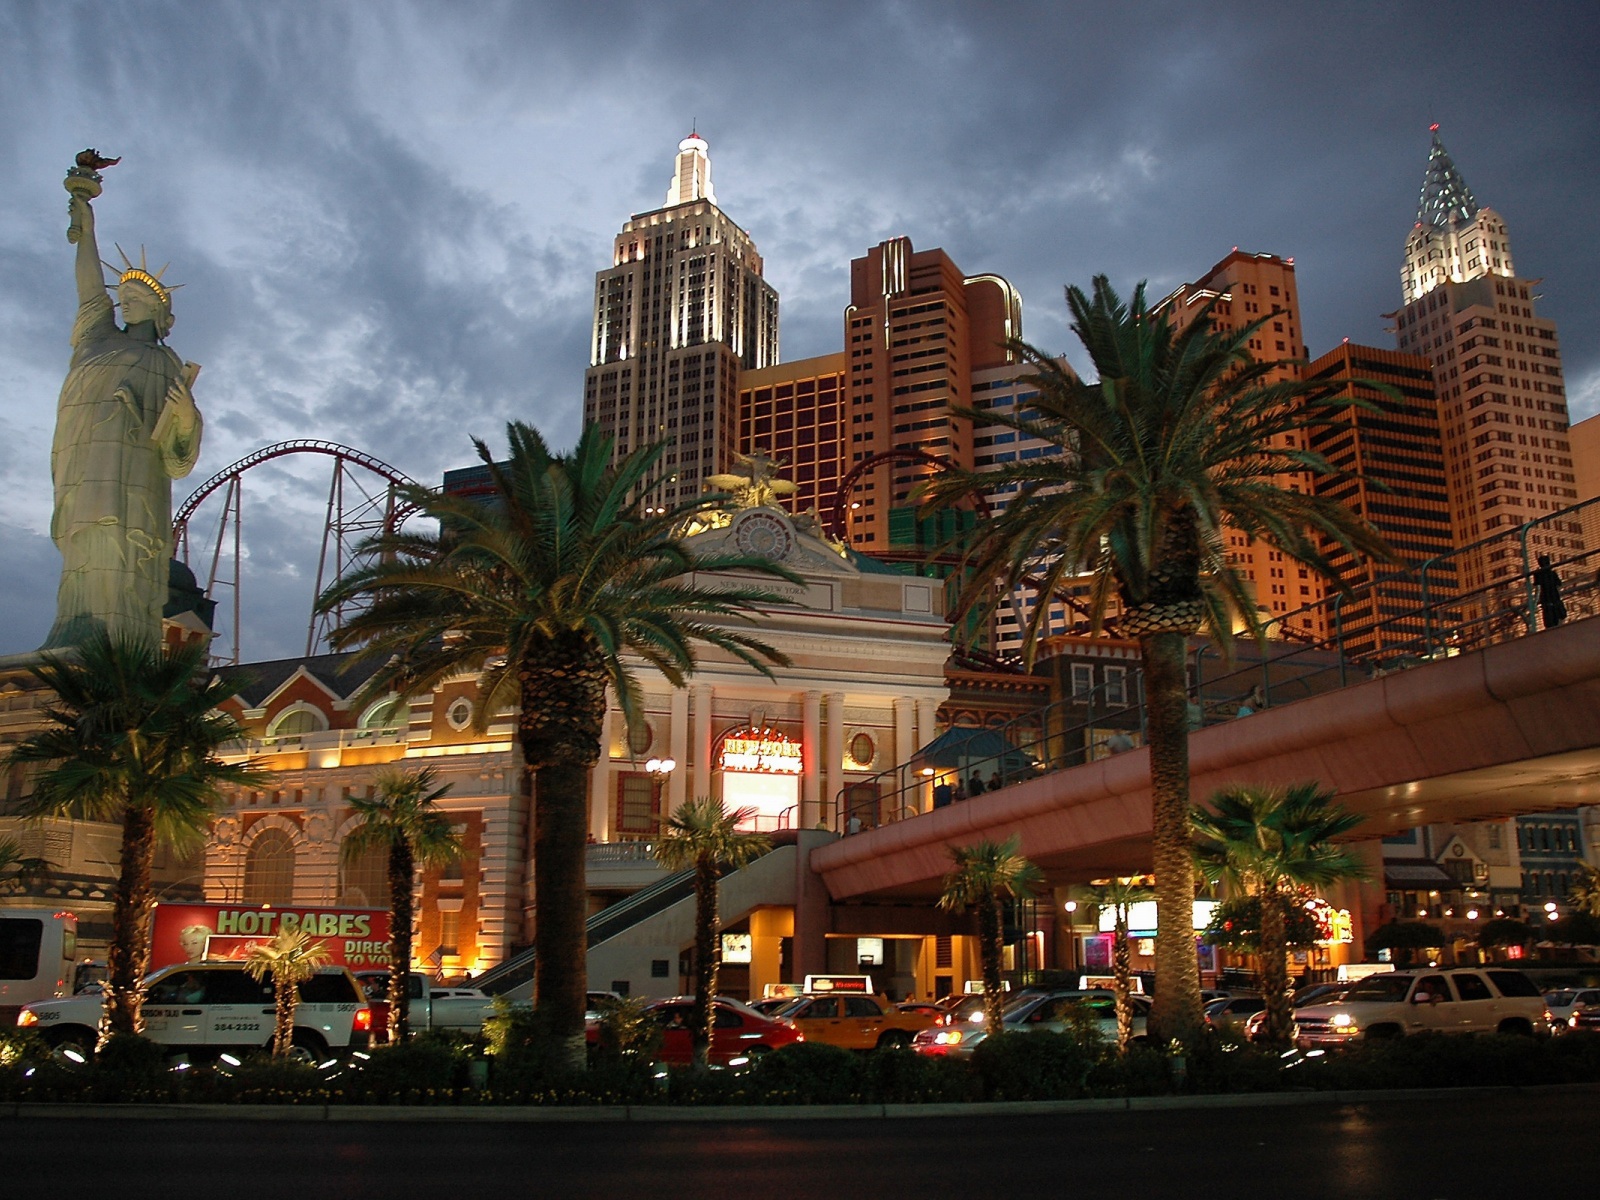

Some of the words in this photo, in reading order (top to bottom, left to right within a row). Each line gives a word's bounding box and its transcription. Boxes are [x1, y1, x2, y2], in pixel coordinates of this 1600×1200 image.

[720, 581, 737, 589] NEW
[741, 583, 762, 592] YORK
[764, 585, 782, 593] NEW
[784, 586, 805, 596] YORK
[724, 739, 759, 755] NEW
[760, 740, 803, 757] YORK
[216, 911, 275, 934] HOT
[280, 912, 371, 938] BABES
[344, 940, 392, 954] DIREC
[344, 954, 365, 966] TO
[213, 1023, 260, 1031] 384-2322
